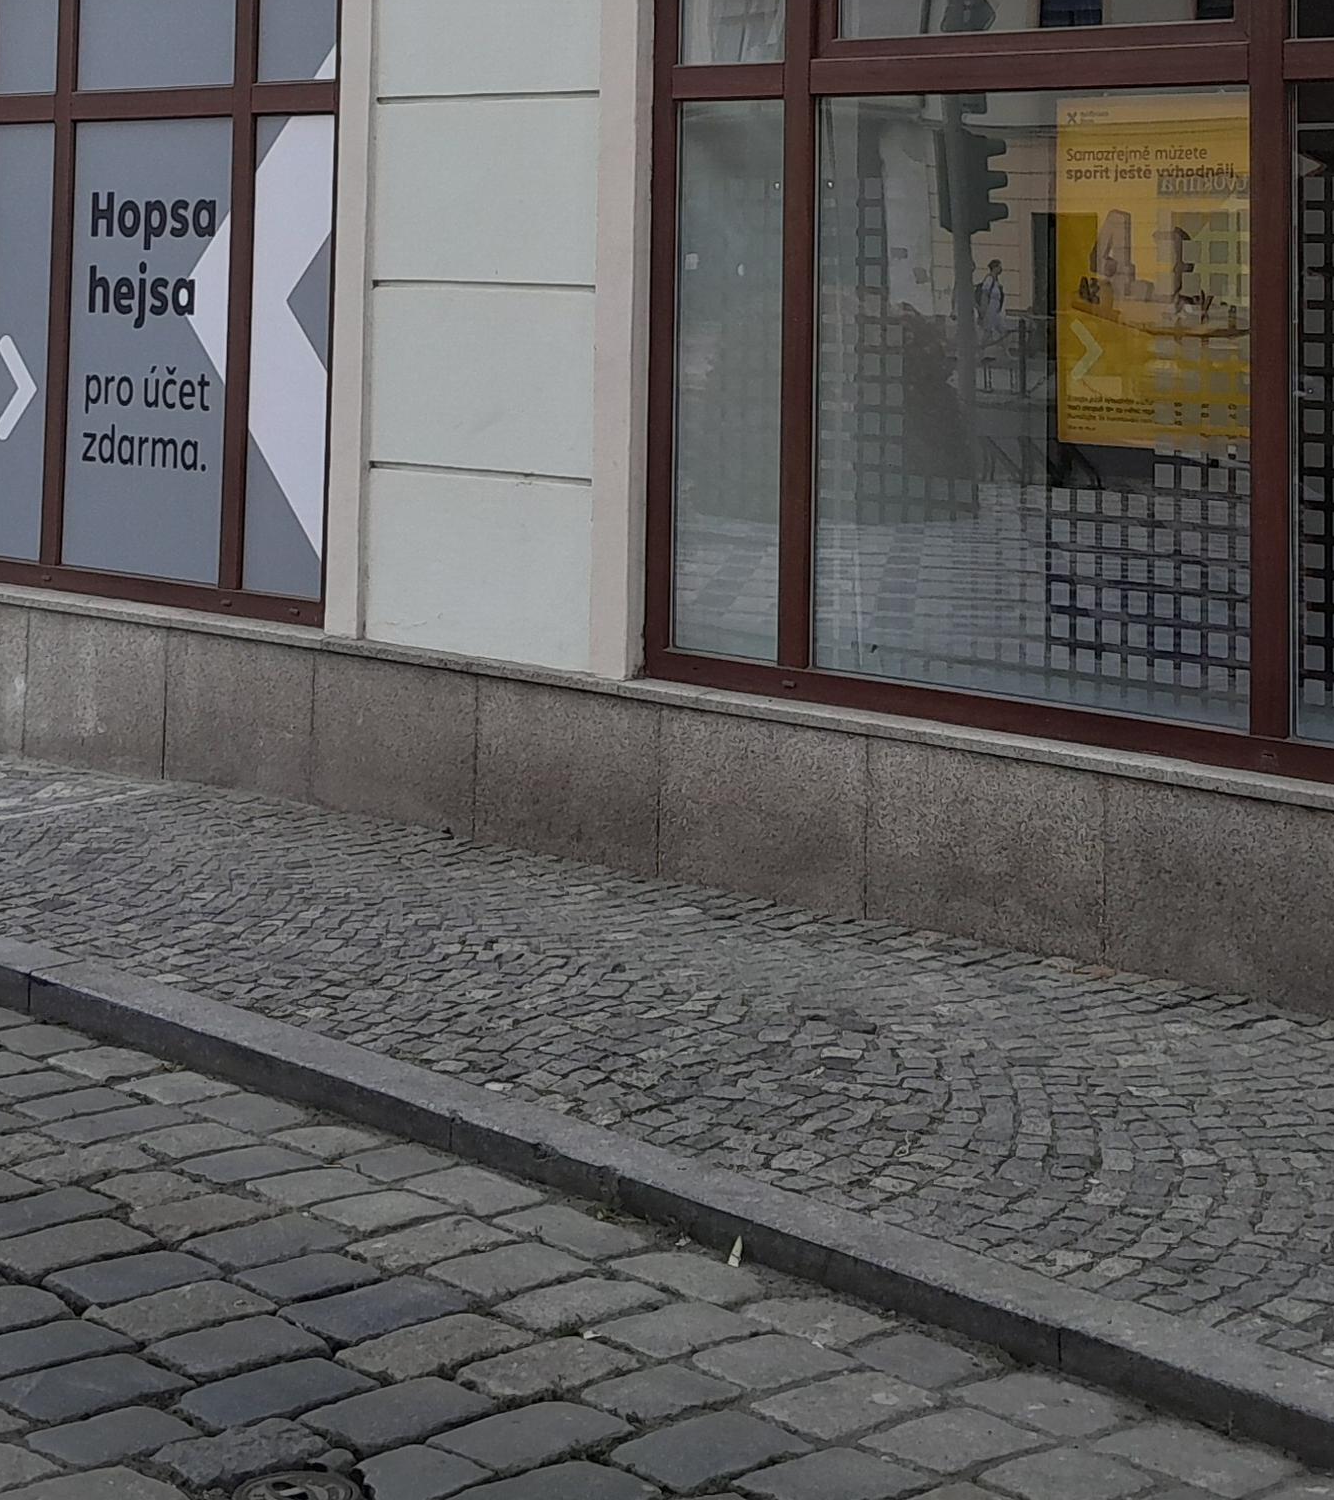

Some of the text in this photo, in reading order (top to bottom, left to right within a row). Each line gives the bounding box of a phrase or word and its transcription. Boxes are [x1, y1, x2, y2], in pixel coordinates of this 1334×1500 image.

[1066, 144, 1208, 164] Samozřejmě můžete
[1066, 164, 1110, 182] spořit
[1113, 163, 1153, 182] ještě
[90, 191, 217, 251] Hopsa
[87, 260, 196, 329] hejsa
[84, 365, 211, 414] pro účet
[81, 423, 208, 472] zdarma.
